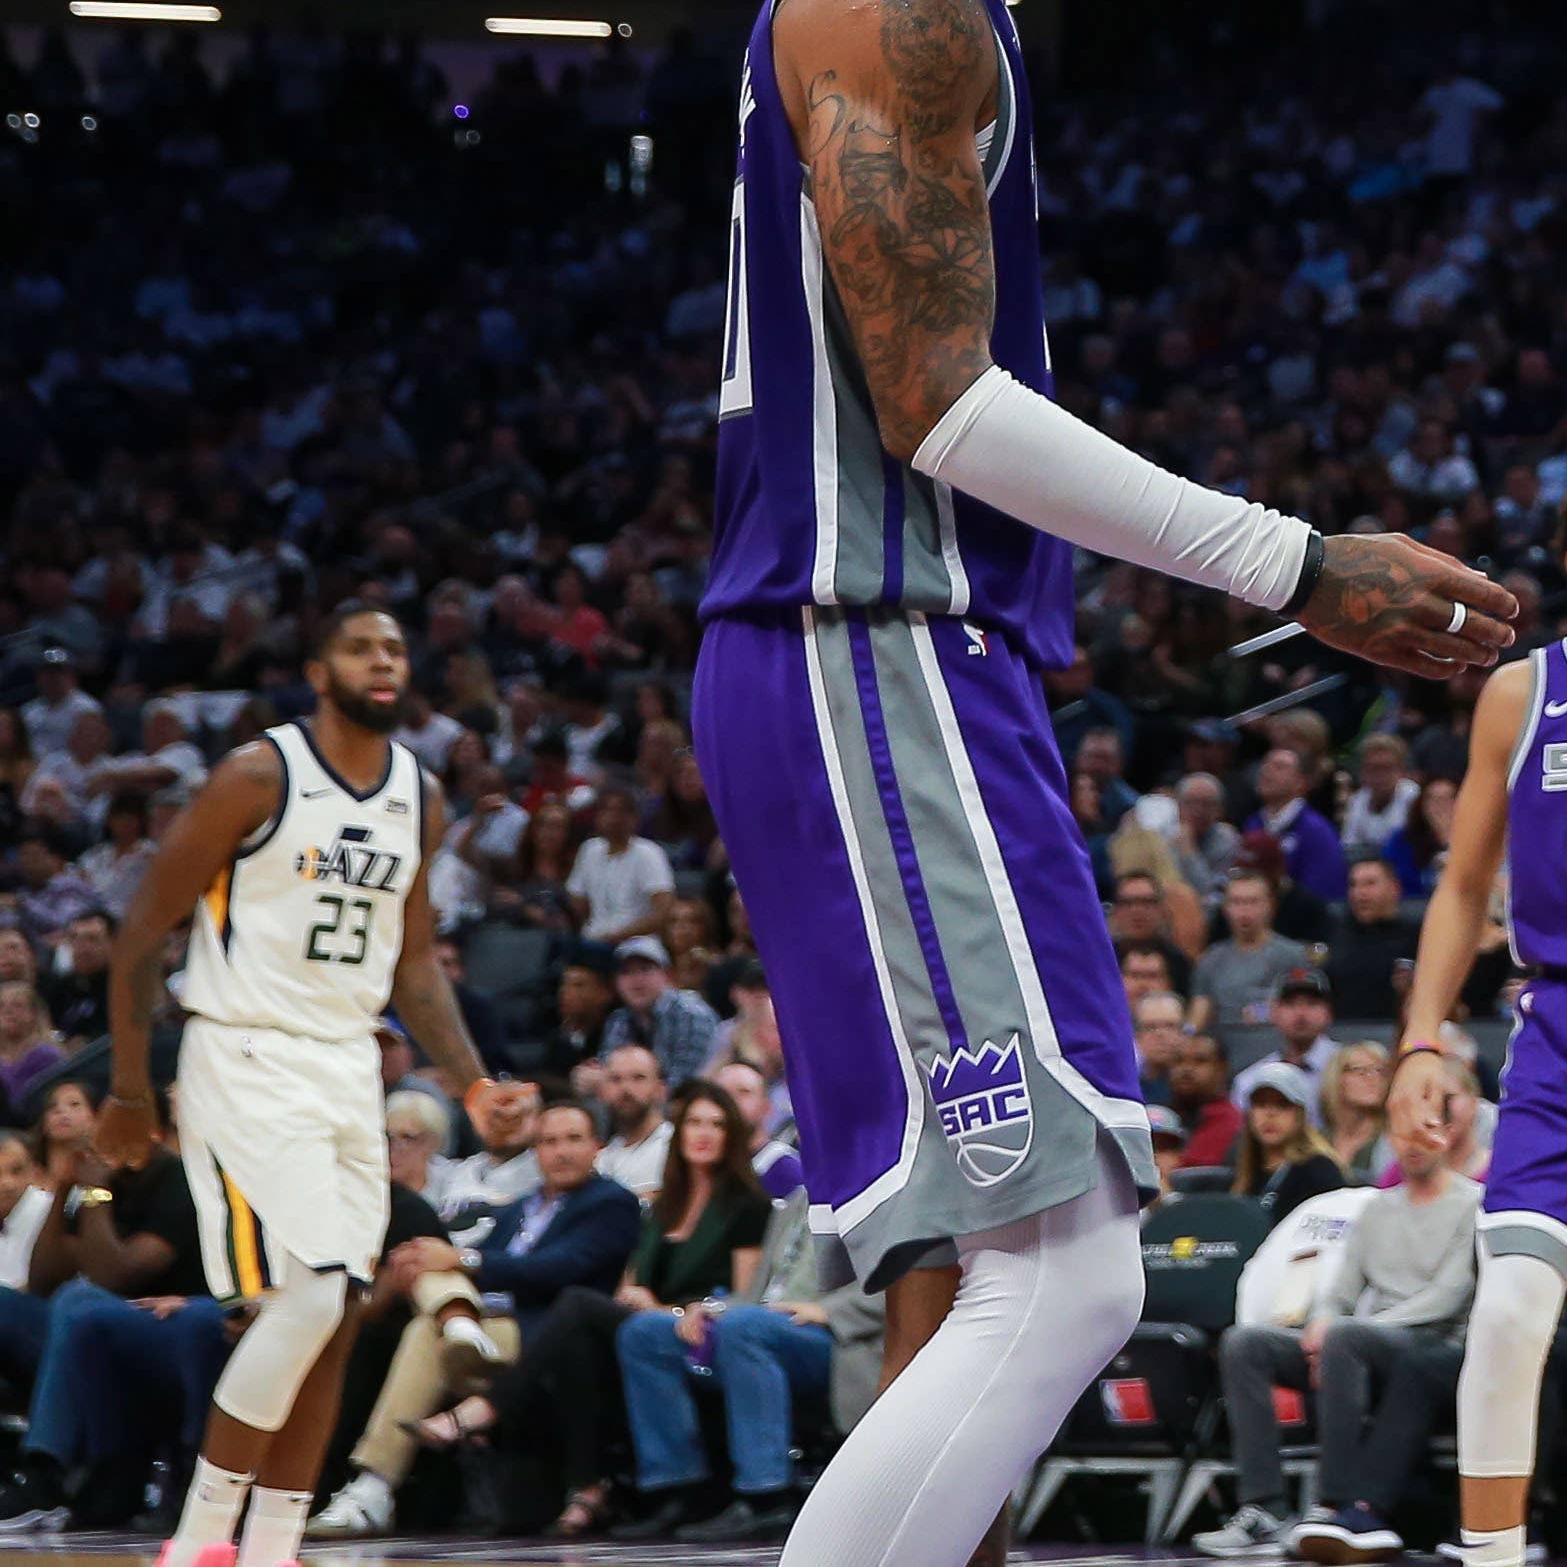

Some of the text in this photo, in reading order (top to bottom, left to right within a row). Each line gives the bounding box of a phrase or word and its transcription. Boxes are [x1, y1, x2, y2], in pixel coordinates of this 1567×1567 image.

[295, 824, 405, 893] JAZZ
[305, 894, 375, 965] 23
[937, 1085, 1032, 1137] SAC
